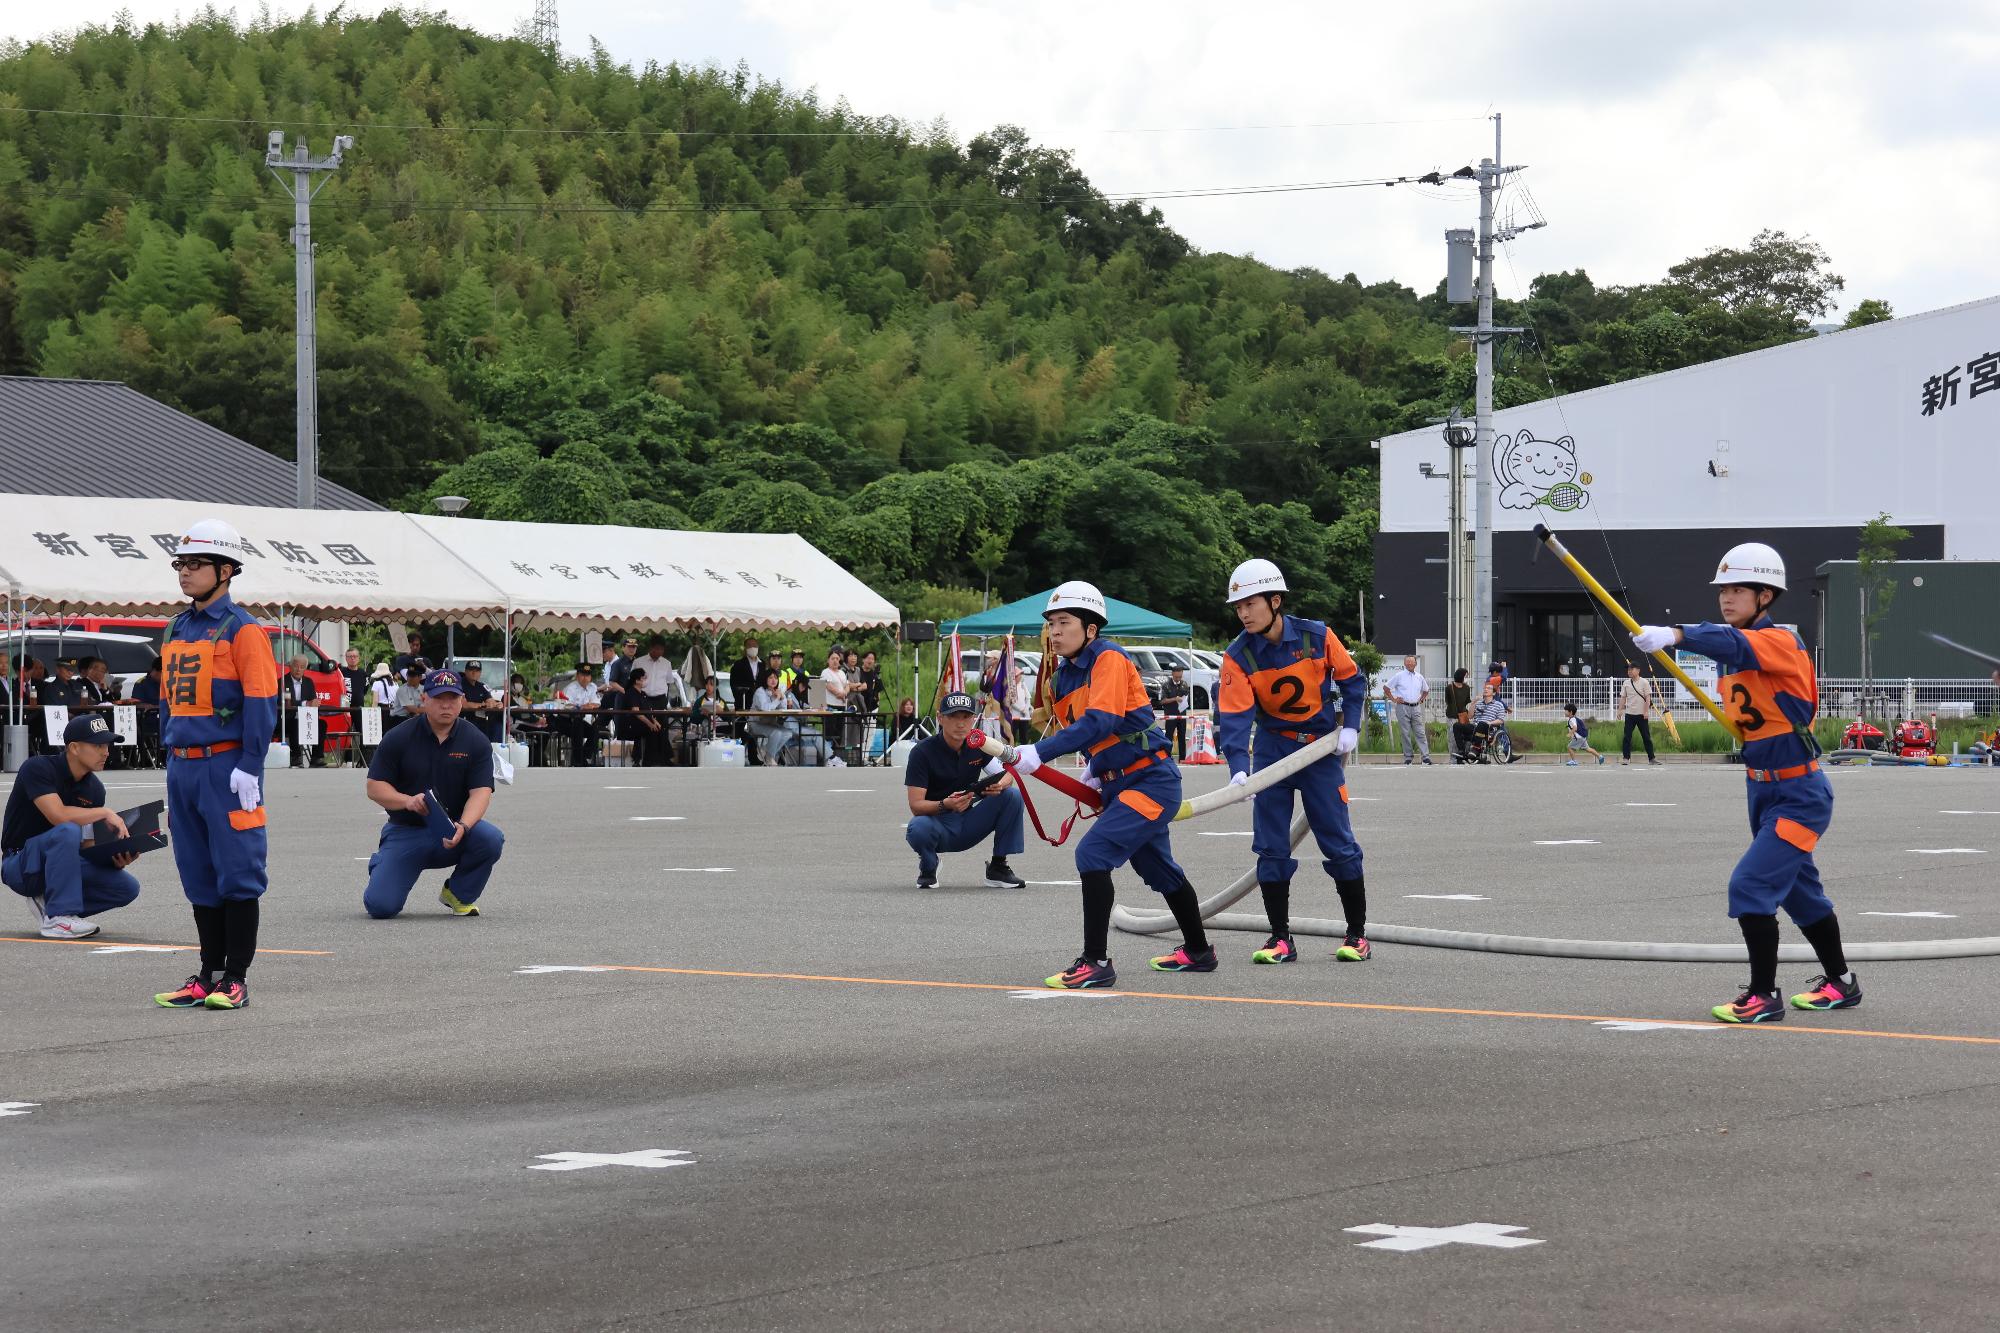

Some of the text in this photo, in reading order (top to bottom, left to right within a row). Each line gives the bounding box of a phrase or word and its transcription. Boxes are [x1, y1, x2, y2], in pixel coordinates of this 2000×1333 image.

[1921, 352, 2000, 416] 新宮
[510, 560, 802, 588] 新宮町教育委員会
[167, 654, 201, 705] 指
[1271, 676, 1310, 714] 2
[1731, 683, 1765, 731] 3
